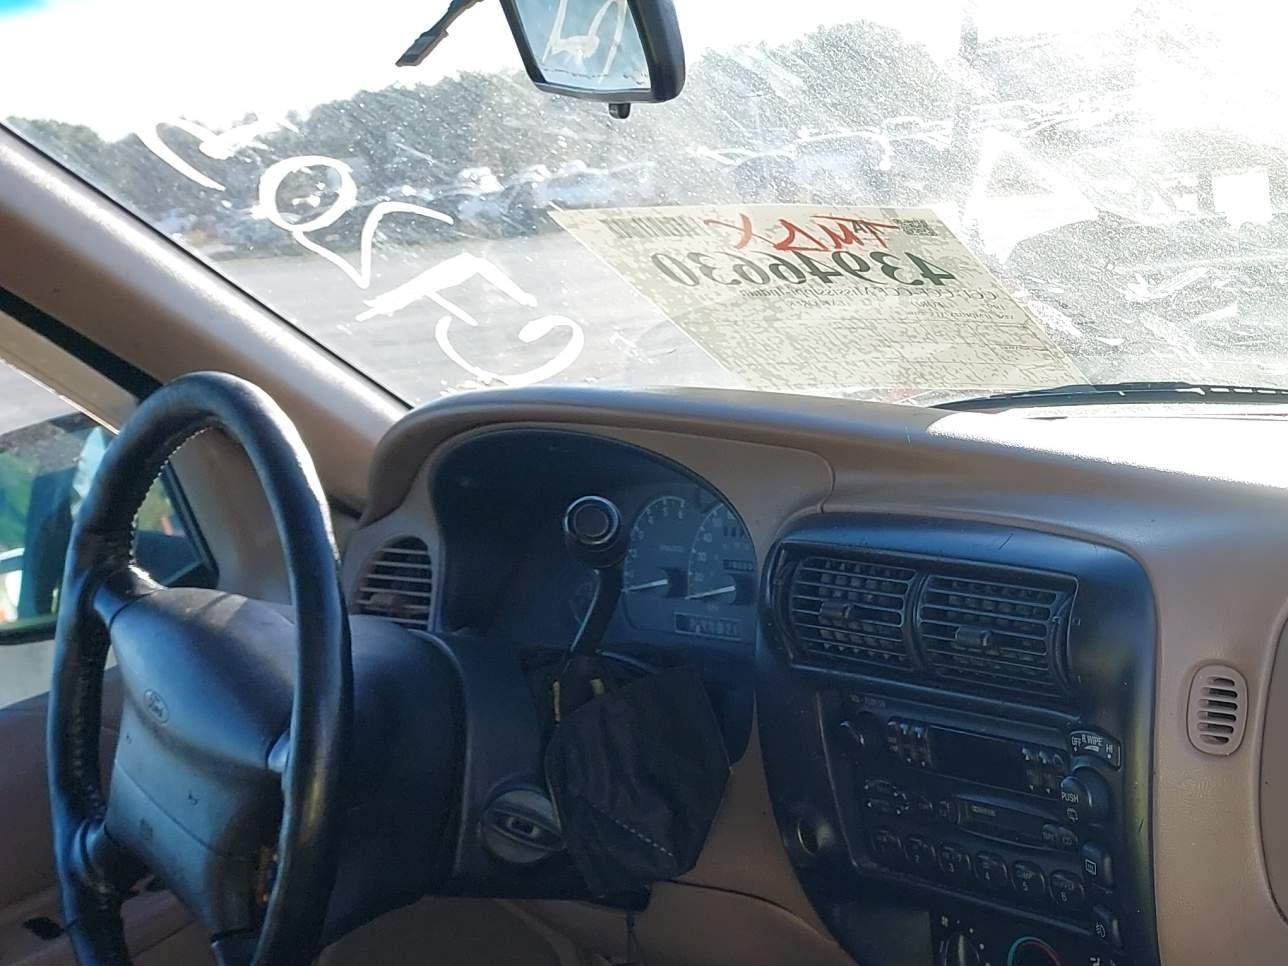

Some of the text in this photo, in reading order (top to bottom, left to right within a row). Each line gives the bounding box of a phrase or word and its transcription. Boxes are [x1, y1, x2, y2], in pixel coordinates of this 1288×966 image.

[1071, 736, 1082, 746] OFF
[1087, 735, 1104, 746] WIPE
[1061, 791, 1079, 803] PUSH
